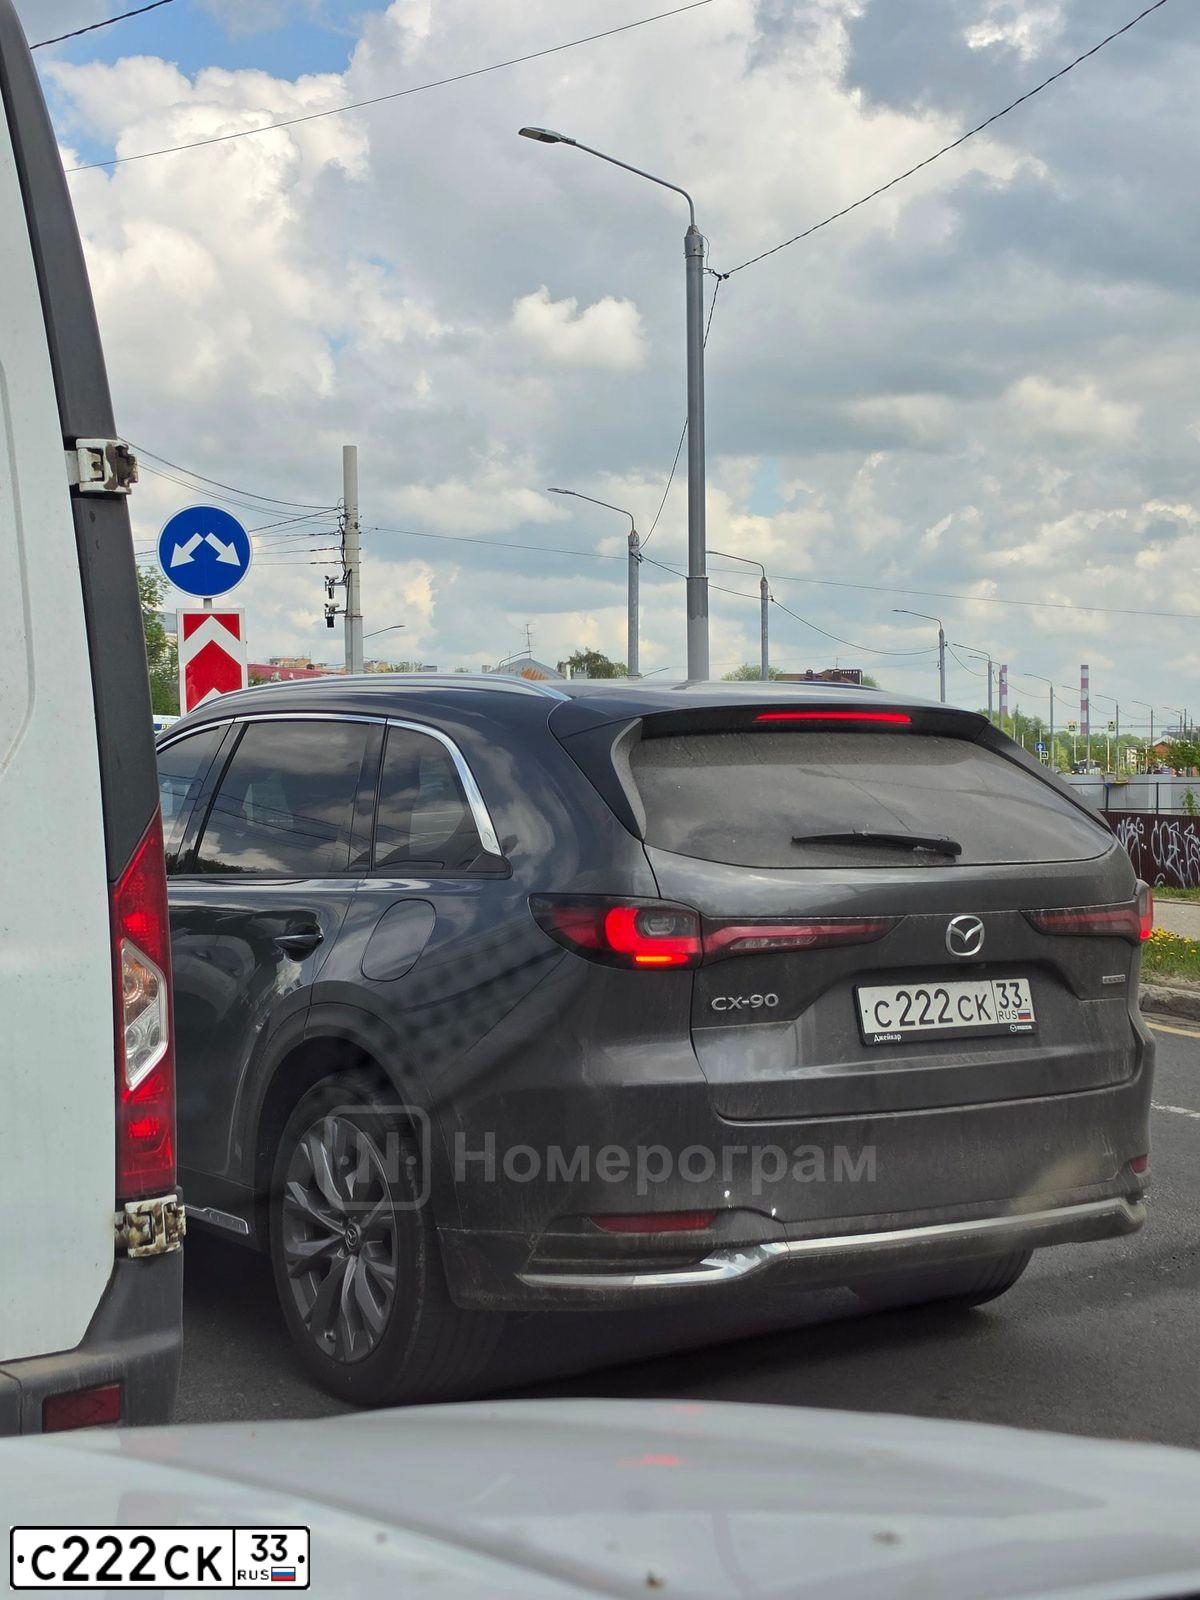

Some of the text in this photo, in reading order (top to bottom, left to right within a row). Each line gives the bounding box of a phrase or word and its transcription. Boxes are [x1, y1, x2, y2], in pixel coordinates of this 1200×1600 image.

[711, 993, 779, 1010] CX-90
[874, 982, 1023, 1028] С222СК 33
[998, 1010, 1018, 1021] RUS
